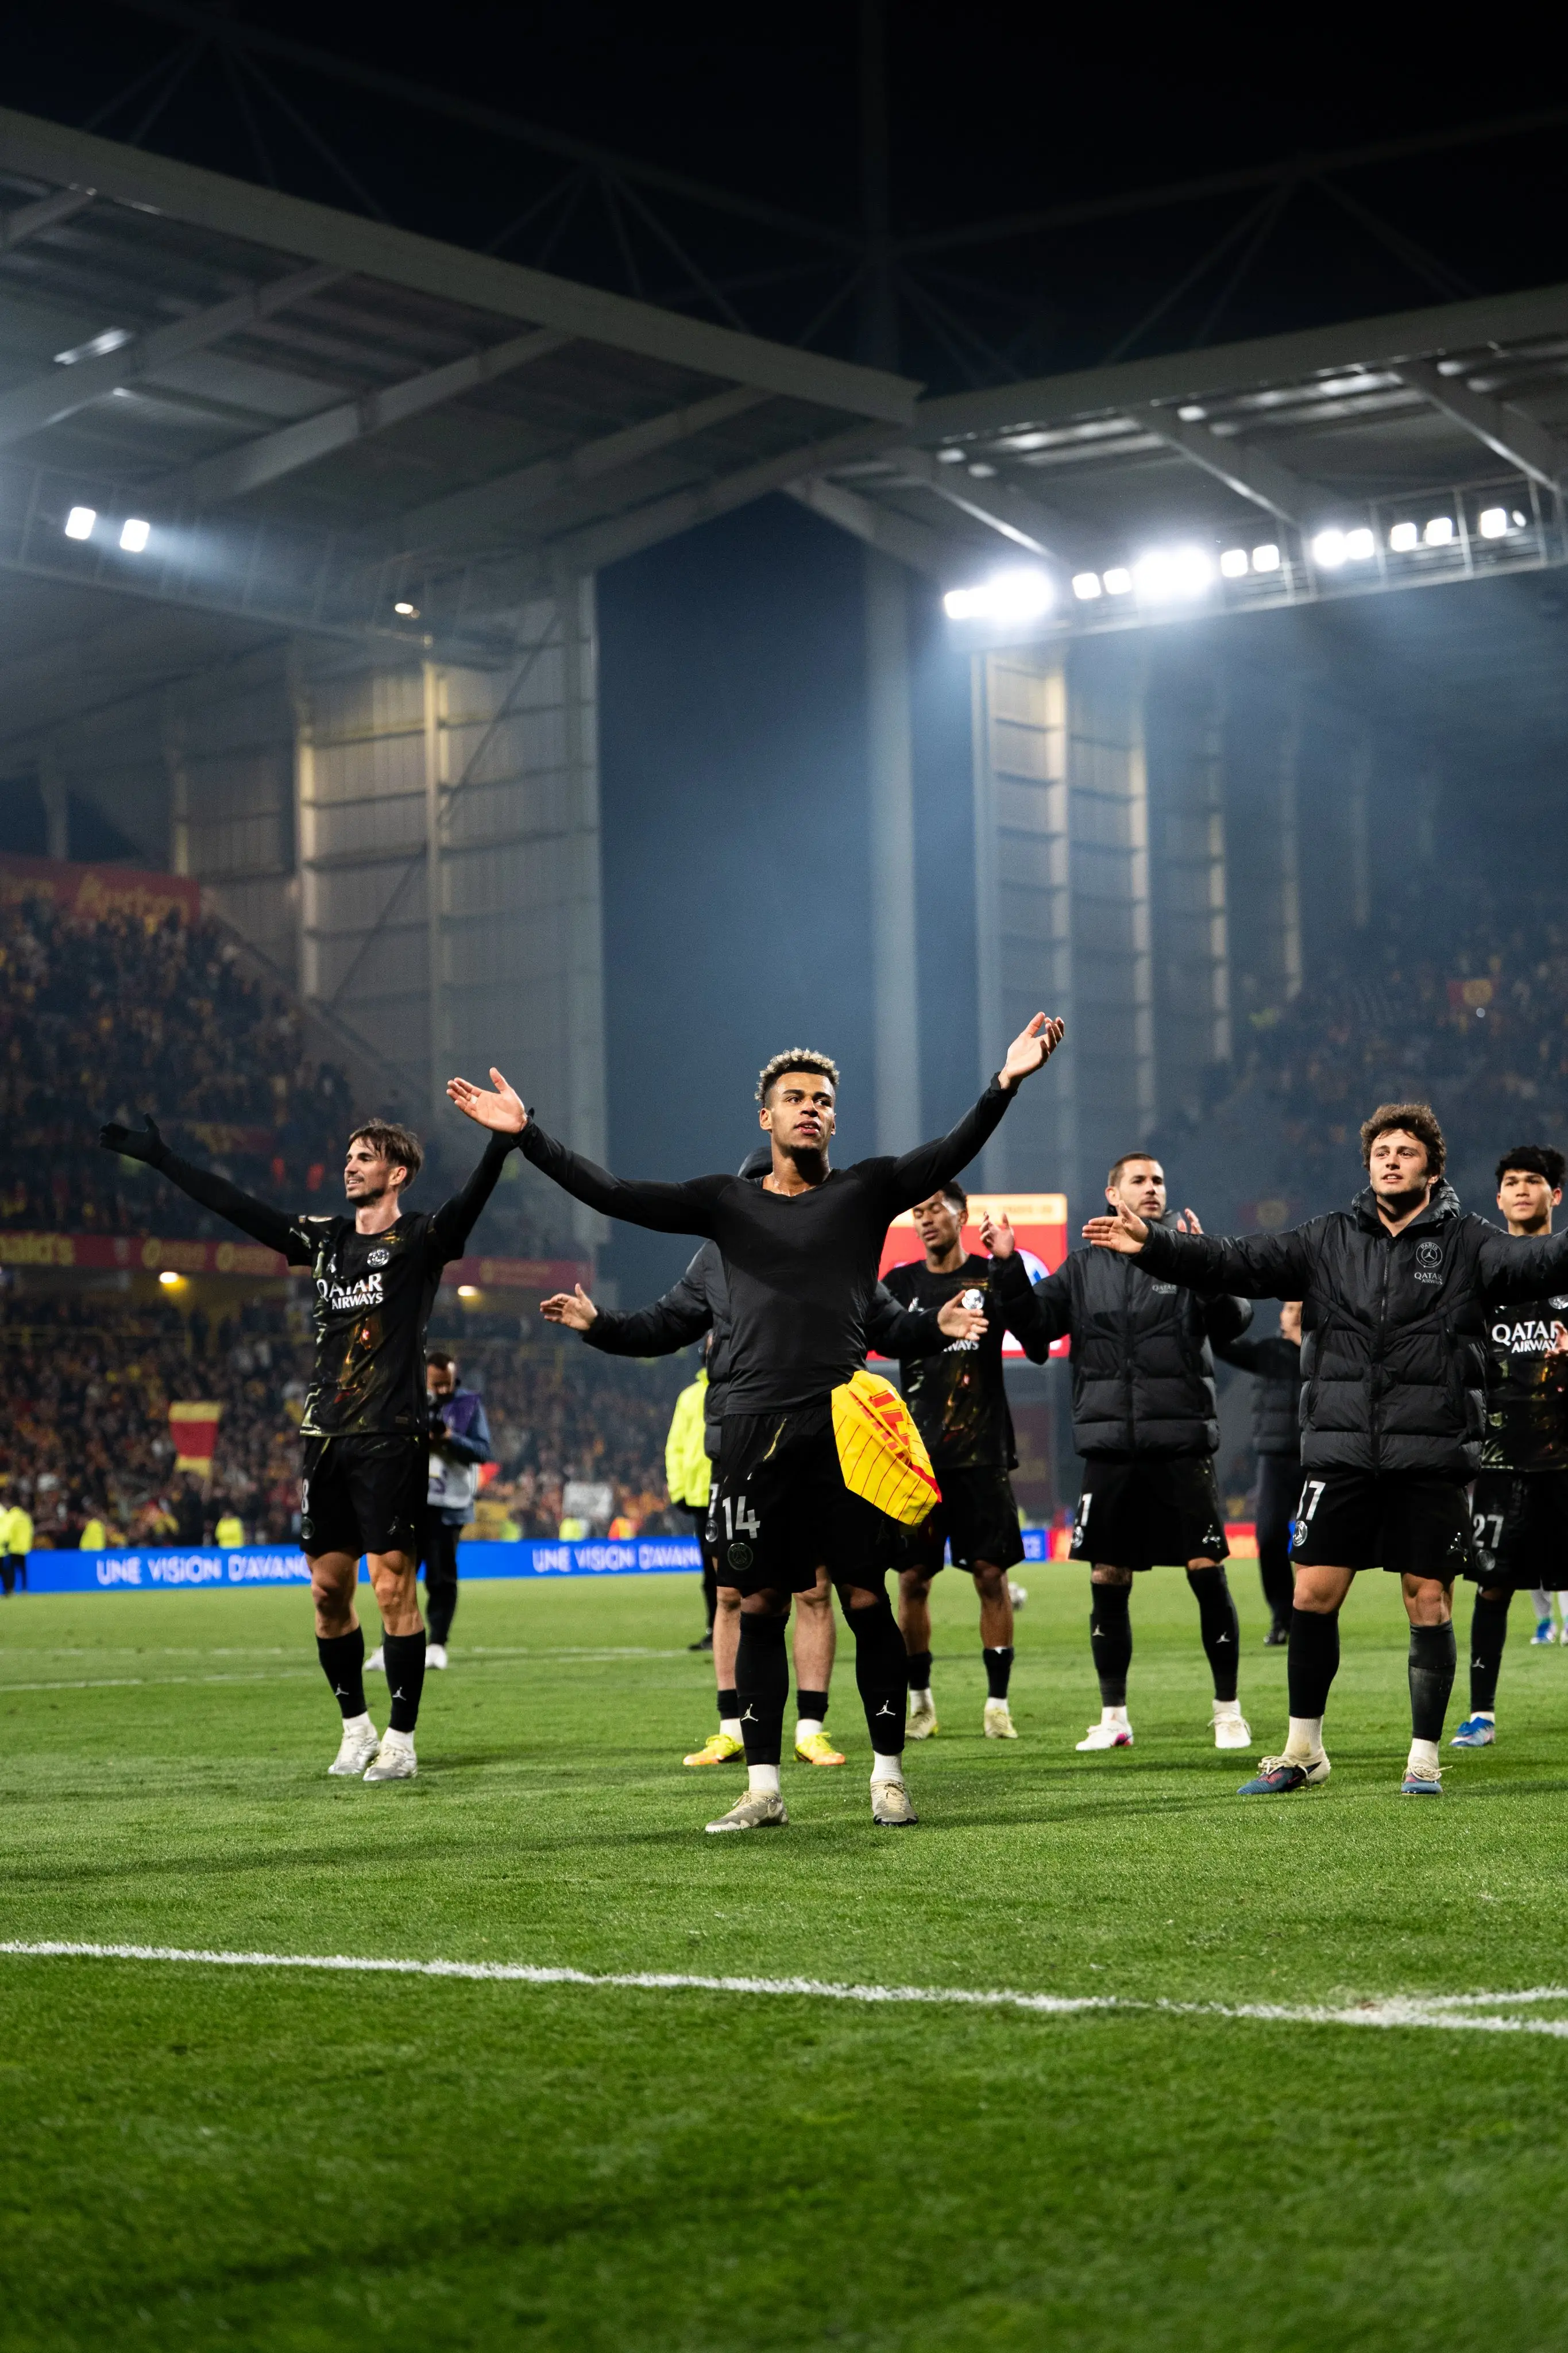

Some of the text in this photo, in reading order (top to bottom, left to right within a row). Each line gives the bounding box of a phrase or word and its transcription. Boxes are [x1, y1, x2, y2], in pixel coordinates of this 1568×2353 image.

[316, 1272, 384, 1302] QATAR
[1414, 1272, 1442, 1280] QATAR
[331, 1293, 384, 1310] AIRWAYS
[943, 1339, 979, 1352] WAYS
[1511, 1339, 1557, 1353] AIRWAY
[302, 1478, 310, 1514] 8
[1296, 1480, 1326, 1521] 7
[722, 1496, 761, 1540] 14
[1472, 1514, 1504, 1548] 27
[96, 1553, 311, 1586] UNE VISION D'AVANC
[532, 1543, 702, 1573] UNE VISION D'AVAN
